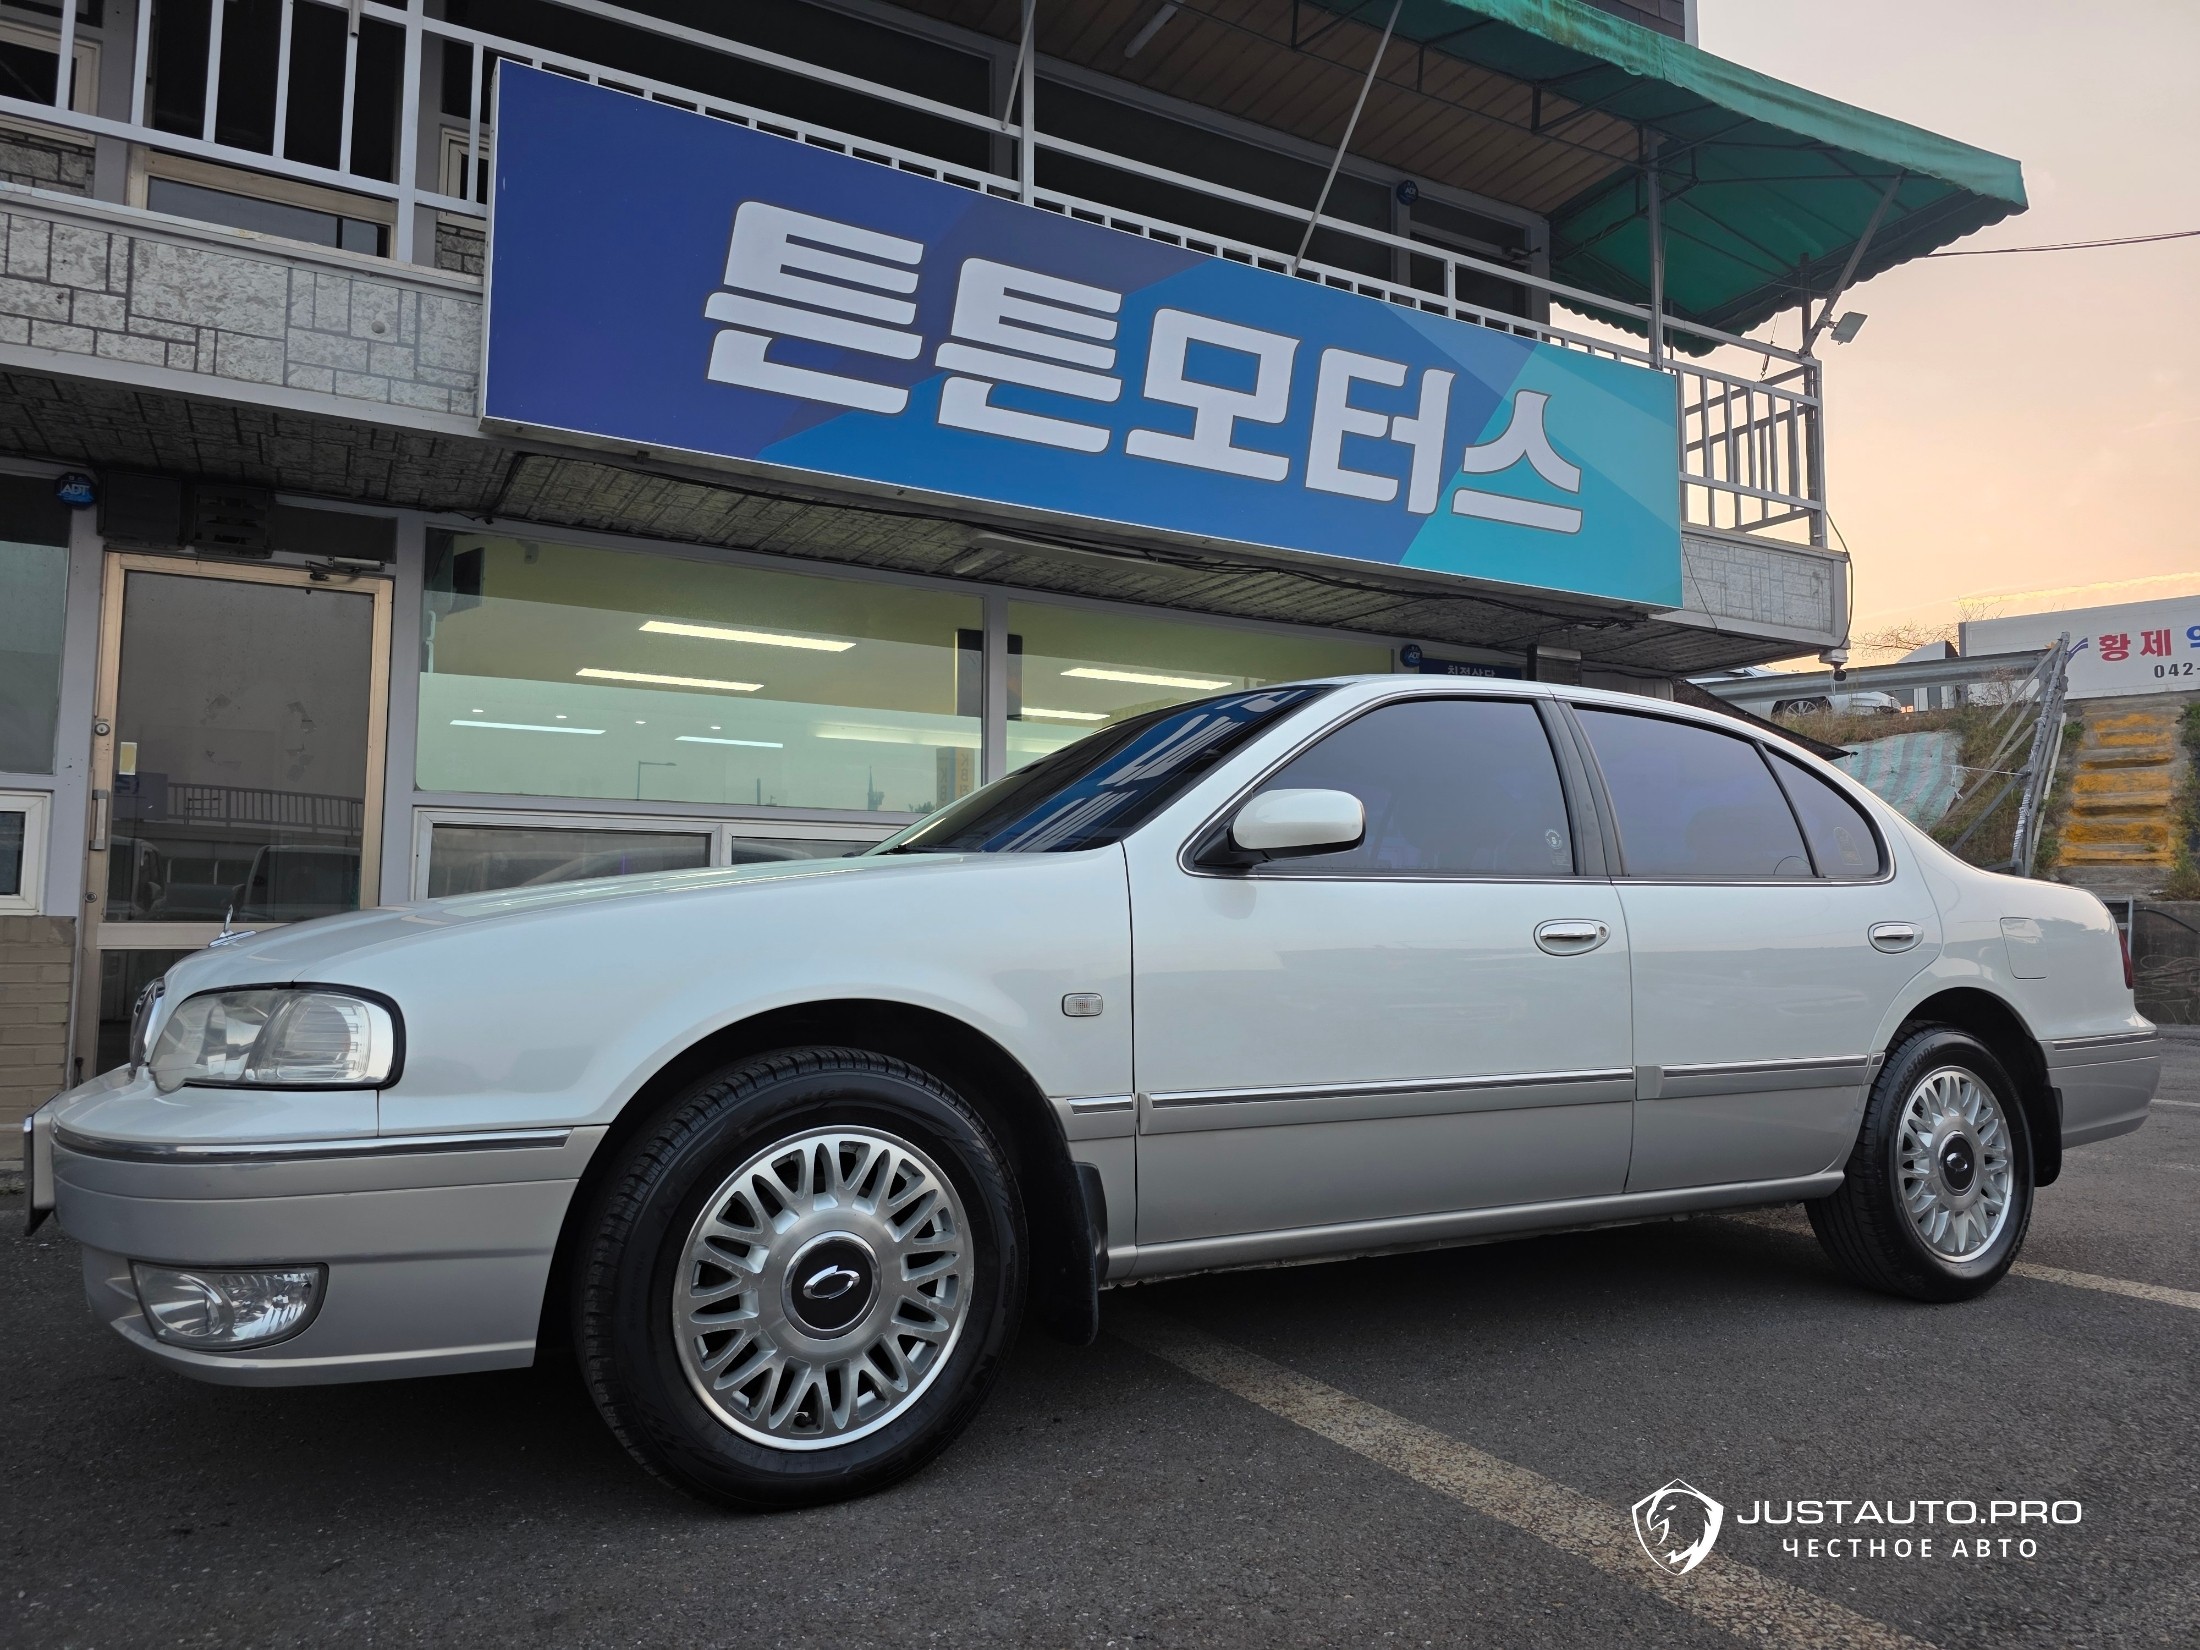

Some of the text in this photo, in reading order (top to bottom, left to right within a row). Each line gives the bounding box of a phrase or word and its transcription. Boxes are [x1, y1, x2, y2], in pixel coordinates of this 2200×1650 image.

[704, 201, 1582, 534] 튼튼모터스
[61, 483, 91, 496] ADT
[2098, 628, 2172, 662] 황제
